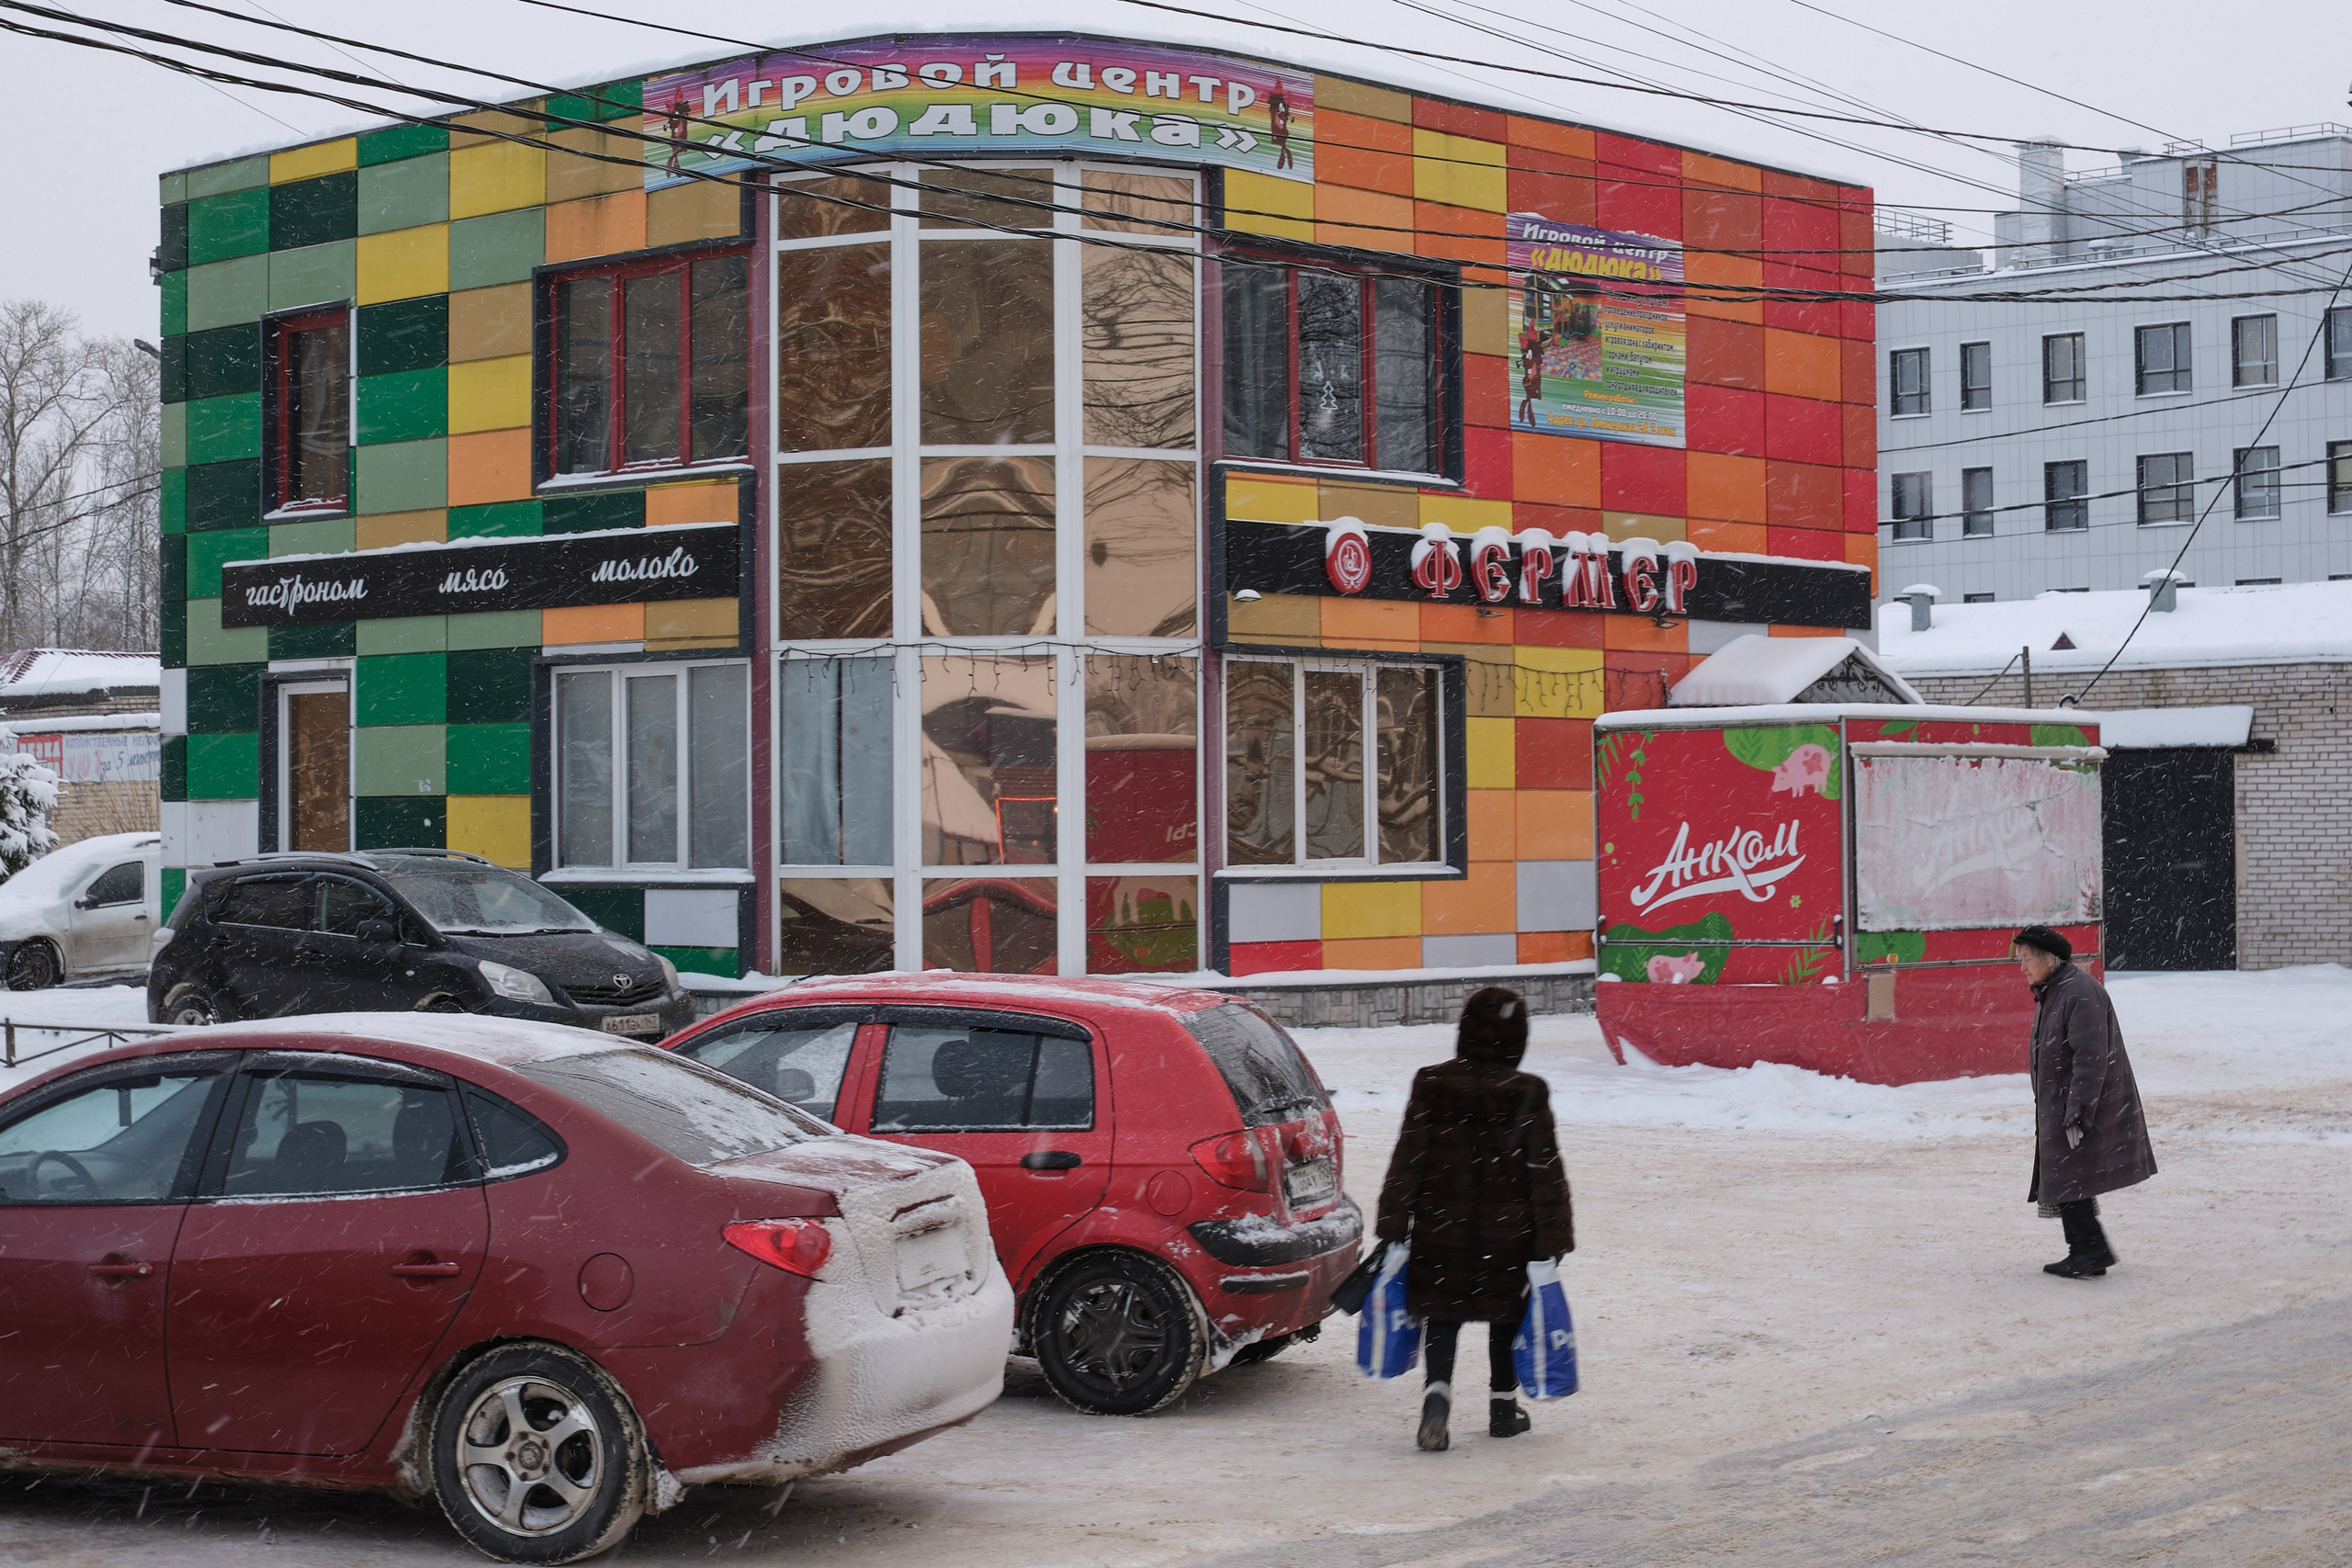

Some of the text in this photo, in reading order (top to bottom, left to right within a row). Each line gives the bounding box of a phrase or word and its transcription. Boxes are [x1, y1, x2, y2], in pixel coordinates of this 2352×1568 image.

[245, 546, 699, 616] гастроном мясо молоко
